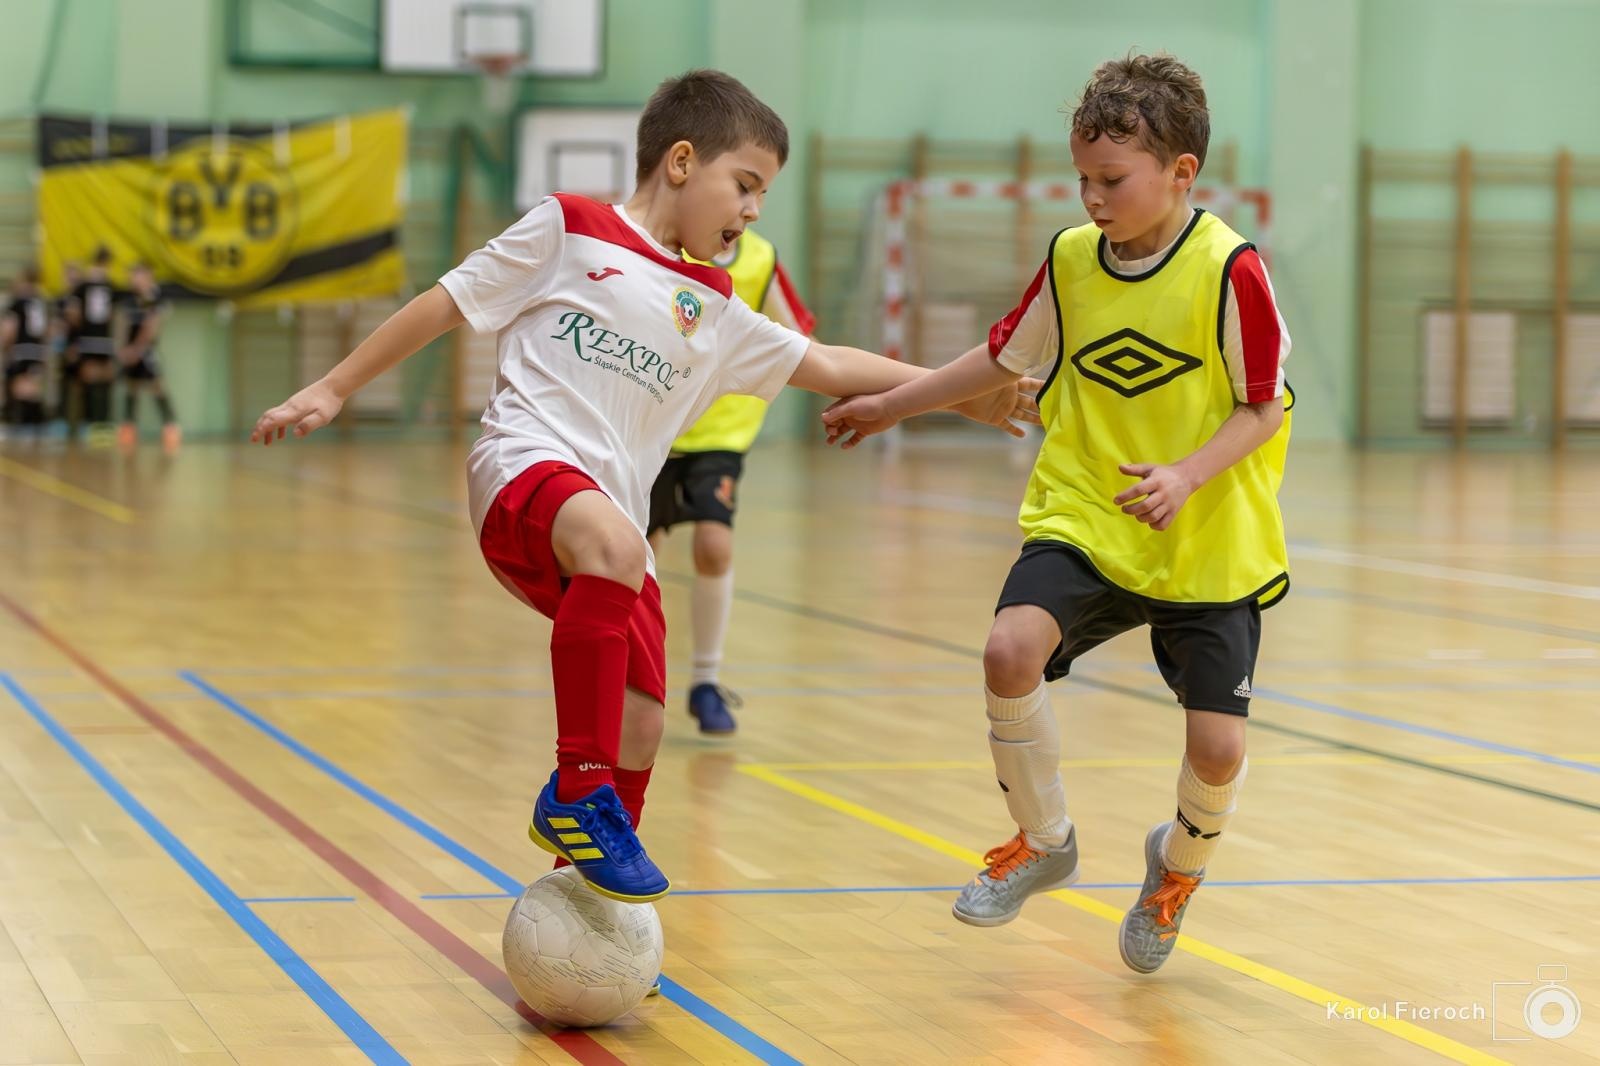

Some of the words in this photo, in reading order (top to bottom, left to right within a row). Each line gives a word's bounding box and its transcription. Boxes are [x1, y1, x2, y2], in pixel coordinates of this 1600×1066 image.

[550, 312, 679, 391] REKPOL
[593, 355, 621, 374] Śląskie
[621, 368, 647, 388] Centrum
